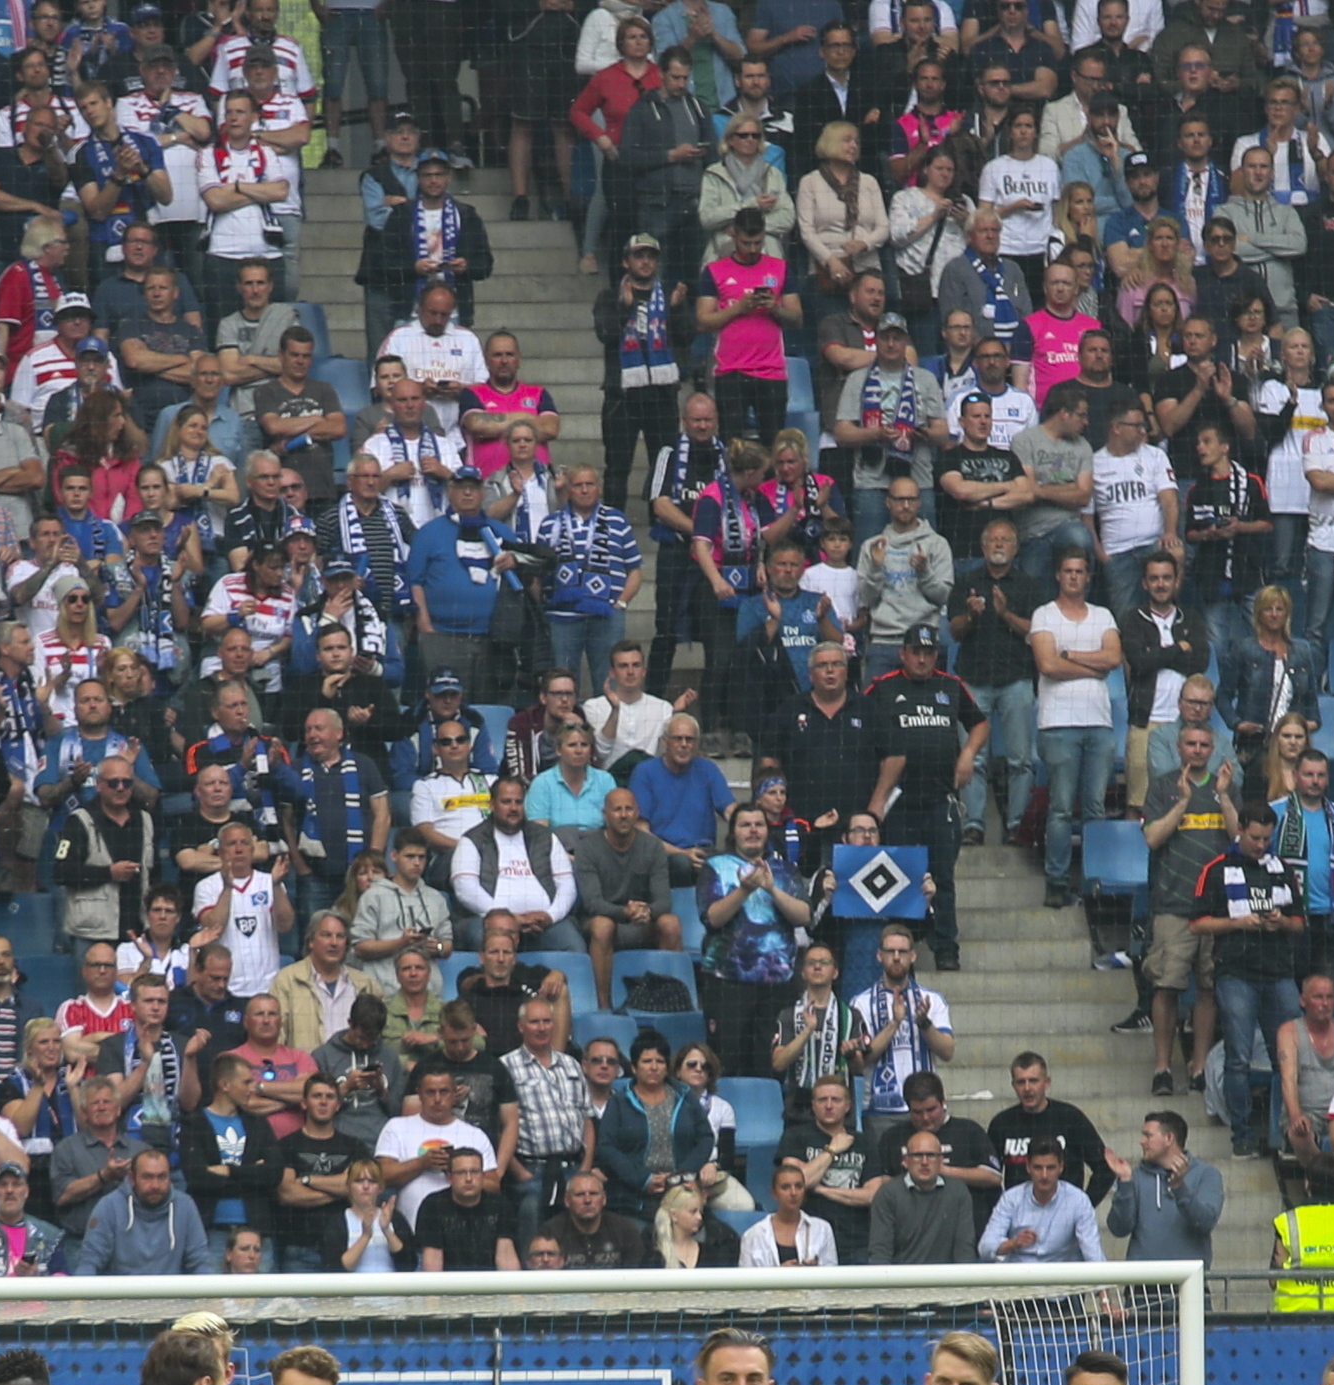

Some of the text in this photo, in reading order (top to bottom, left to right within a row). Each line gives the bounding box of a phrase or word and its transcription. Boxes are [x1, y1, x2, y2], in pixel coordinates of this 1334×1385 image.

[1046, 352, 1079, 364] Emir
[1106, 481, 1146, 503] JEVER
[781, 637, 817, 648] irates
[917, 704, 934, 718] Fly
[899, 714, 950, 728] Emirates
[239, 918, 255, 934] BP
